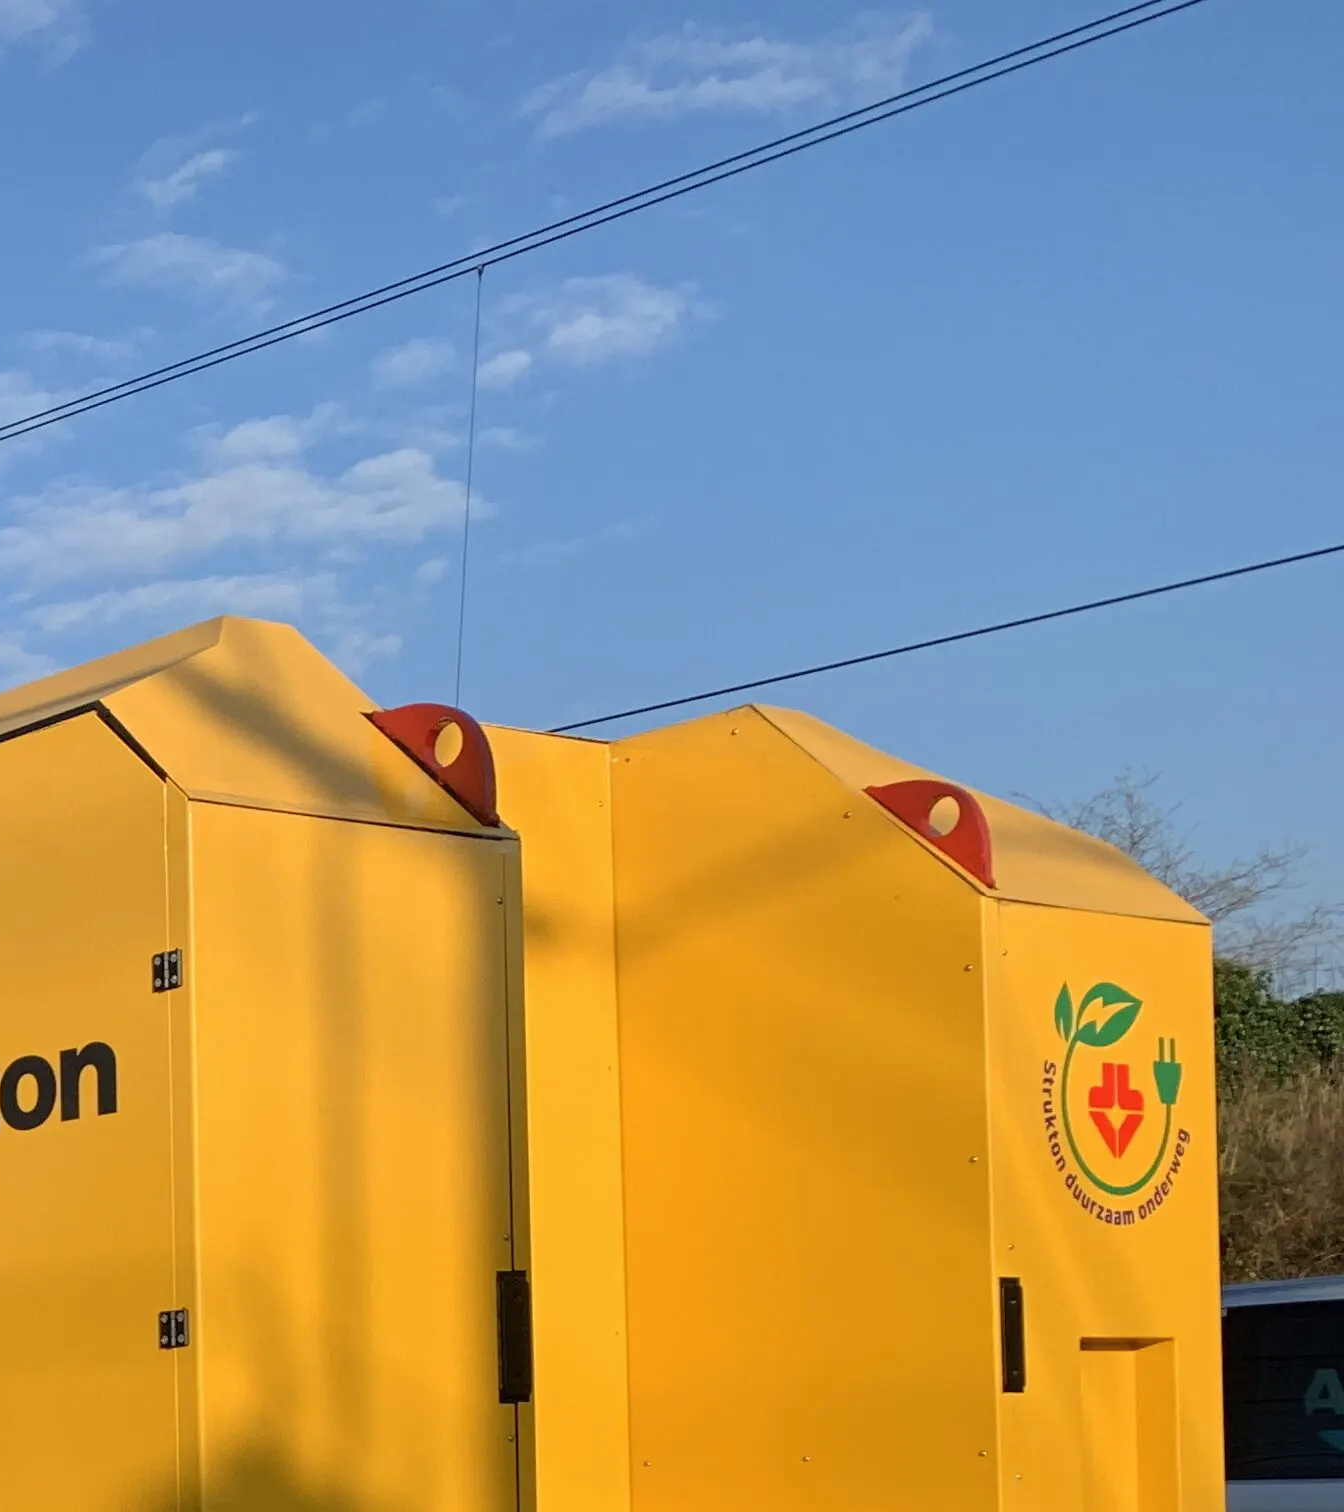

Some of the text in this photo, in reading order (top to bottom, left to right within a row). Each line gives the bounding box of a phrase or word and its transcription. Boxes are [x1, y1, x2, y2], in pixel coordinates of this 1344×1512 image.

[1042, 1059, 1191, 1227] Strukton duurzaam onderweg
